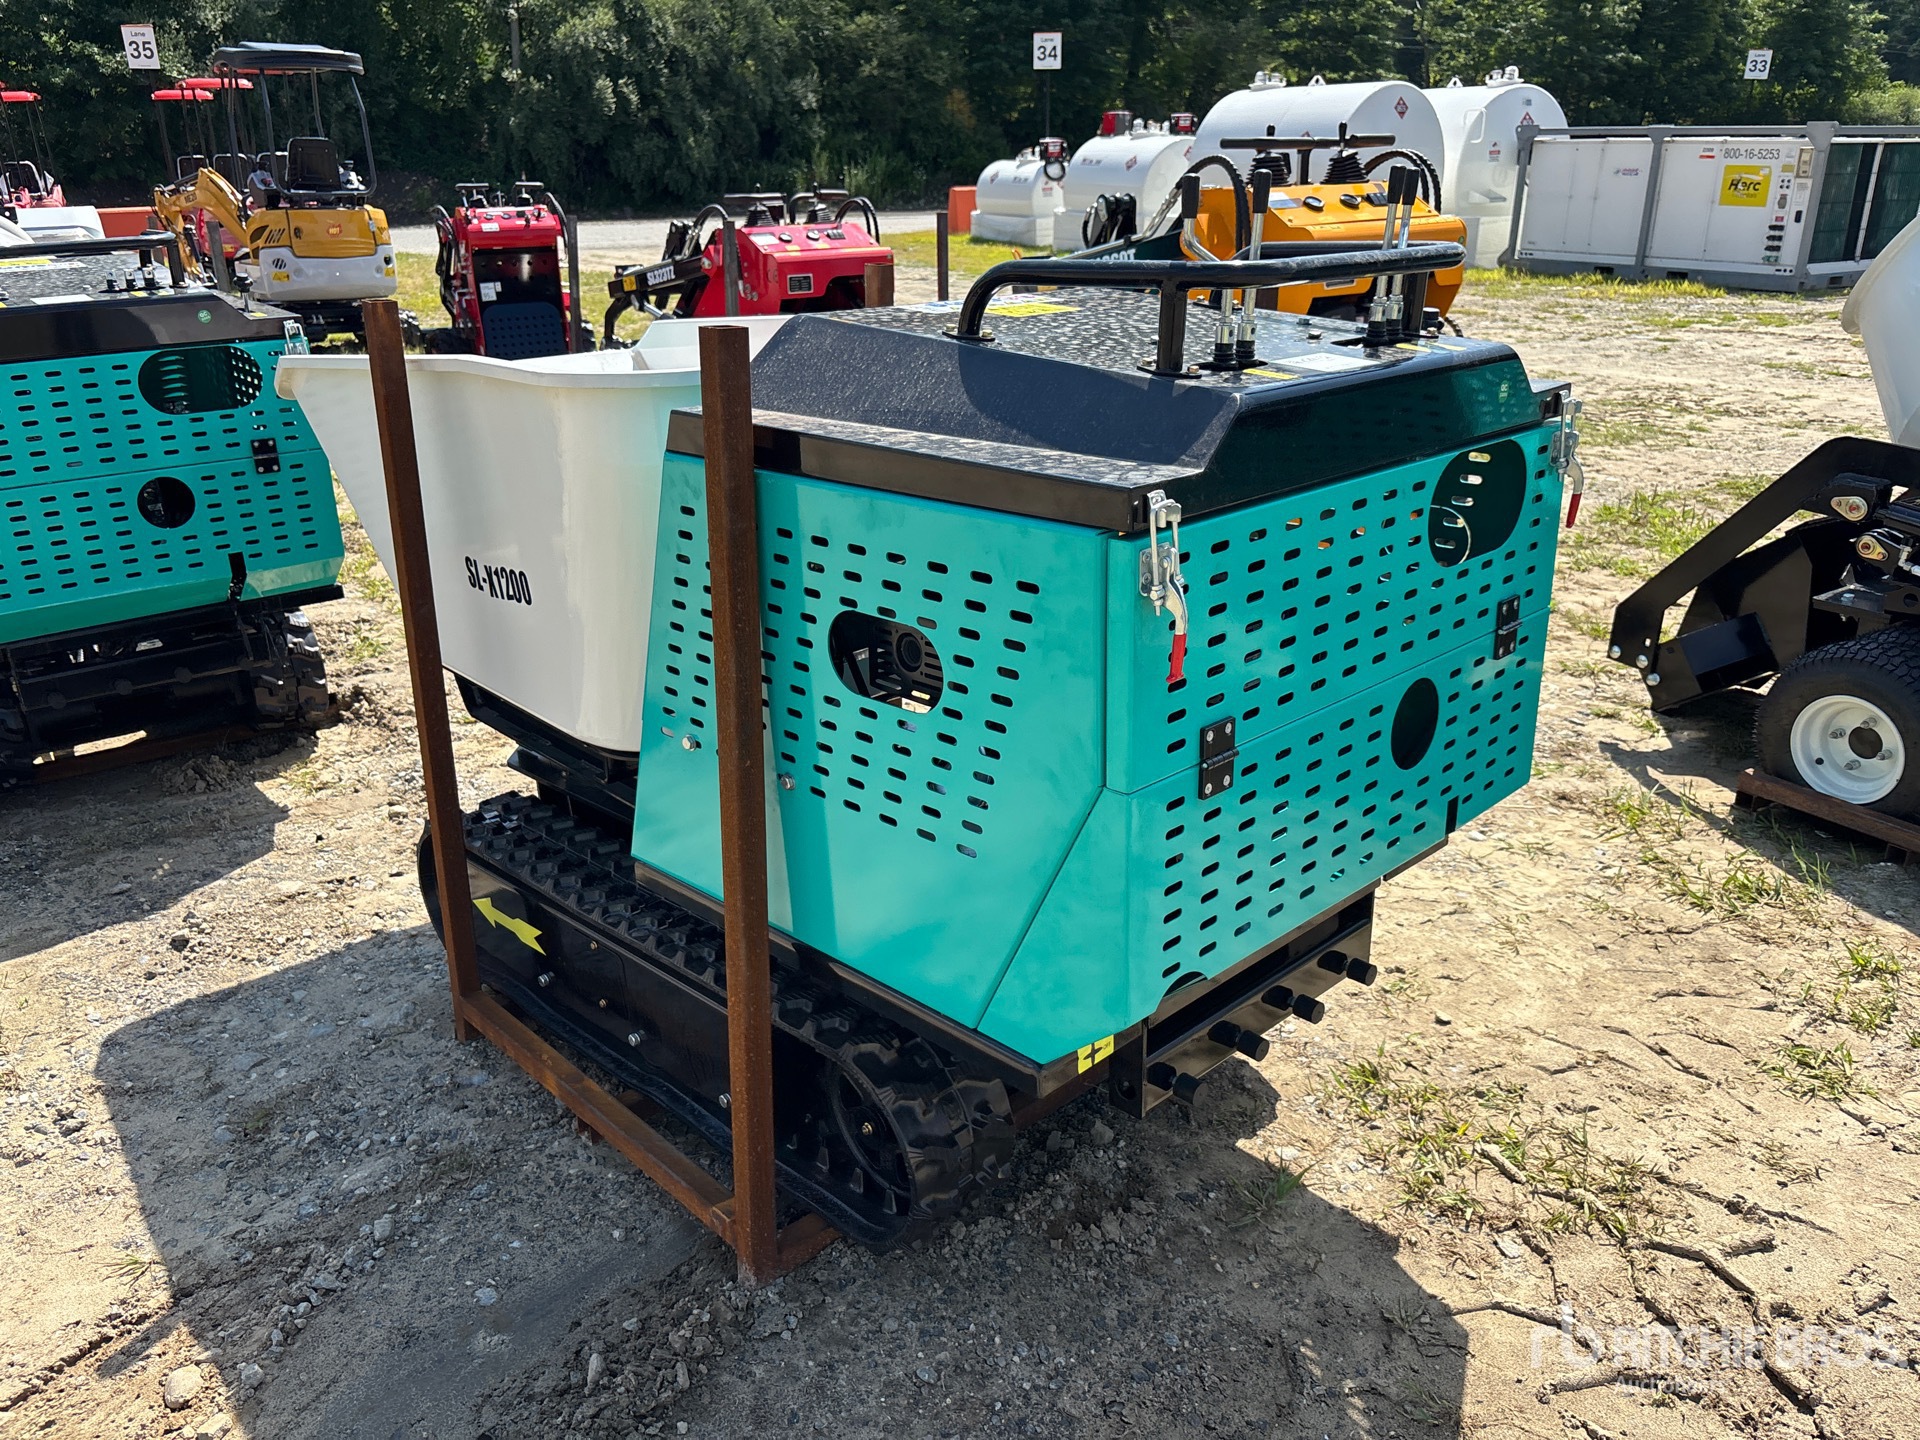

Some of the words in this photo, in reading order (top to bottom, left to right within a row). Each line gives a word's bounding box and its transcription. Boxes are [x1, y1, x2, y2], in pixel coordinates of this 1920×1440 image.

[128, 40, 154, 60] 35
[1037, 45, 1058, 61] 34
[1748, 60, 1768, 72] 33
[1723, 147, 1781, 160] 800-16-5253
[464, 555, 533, 606] SL-X1200
